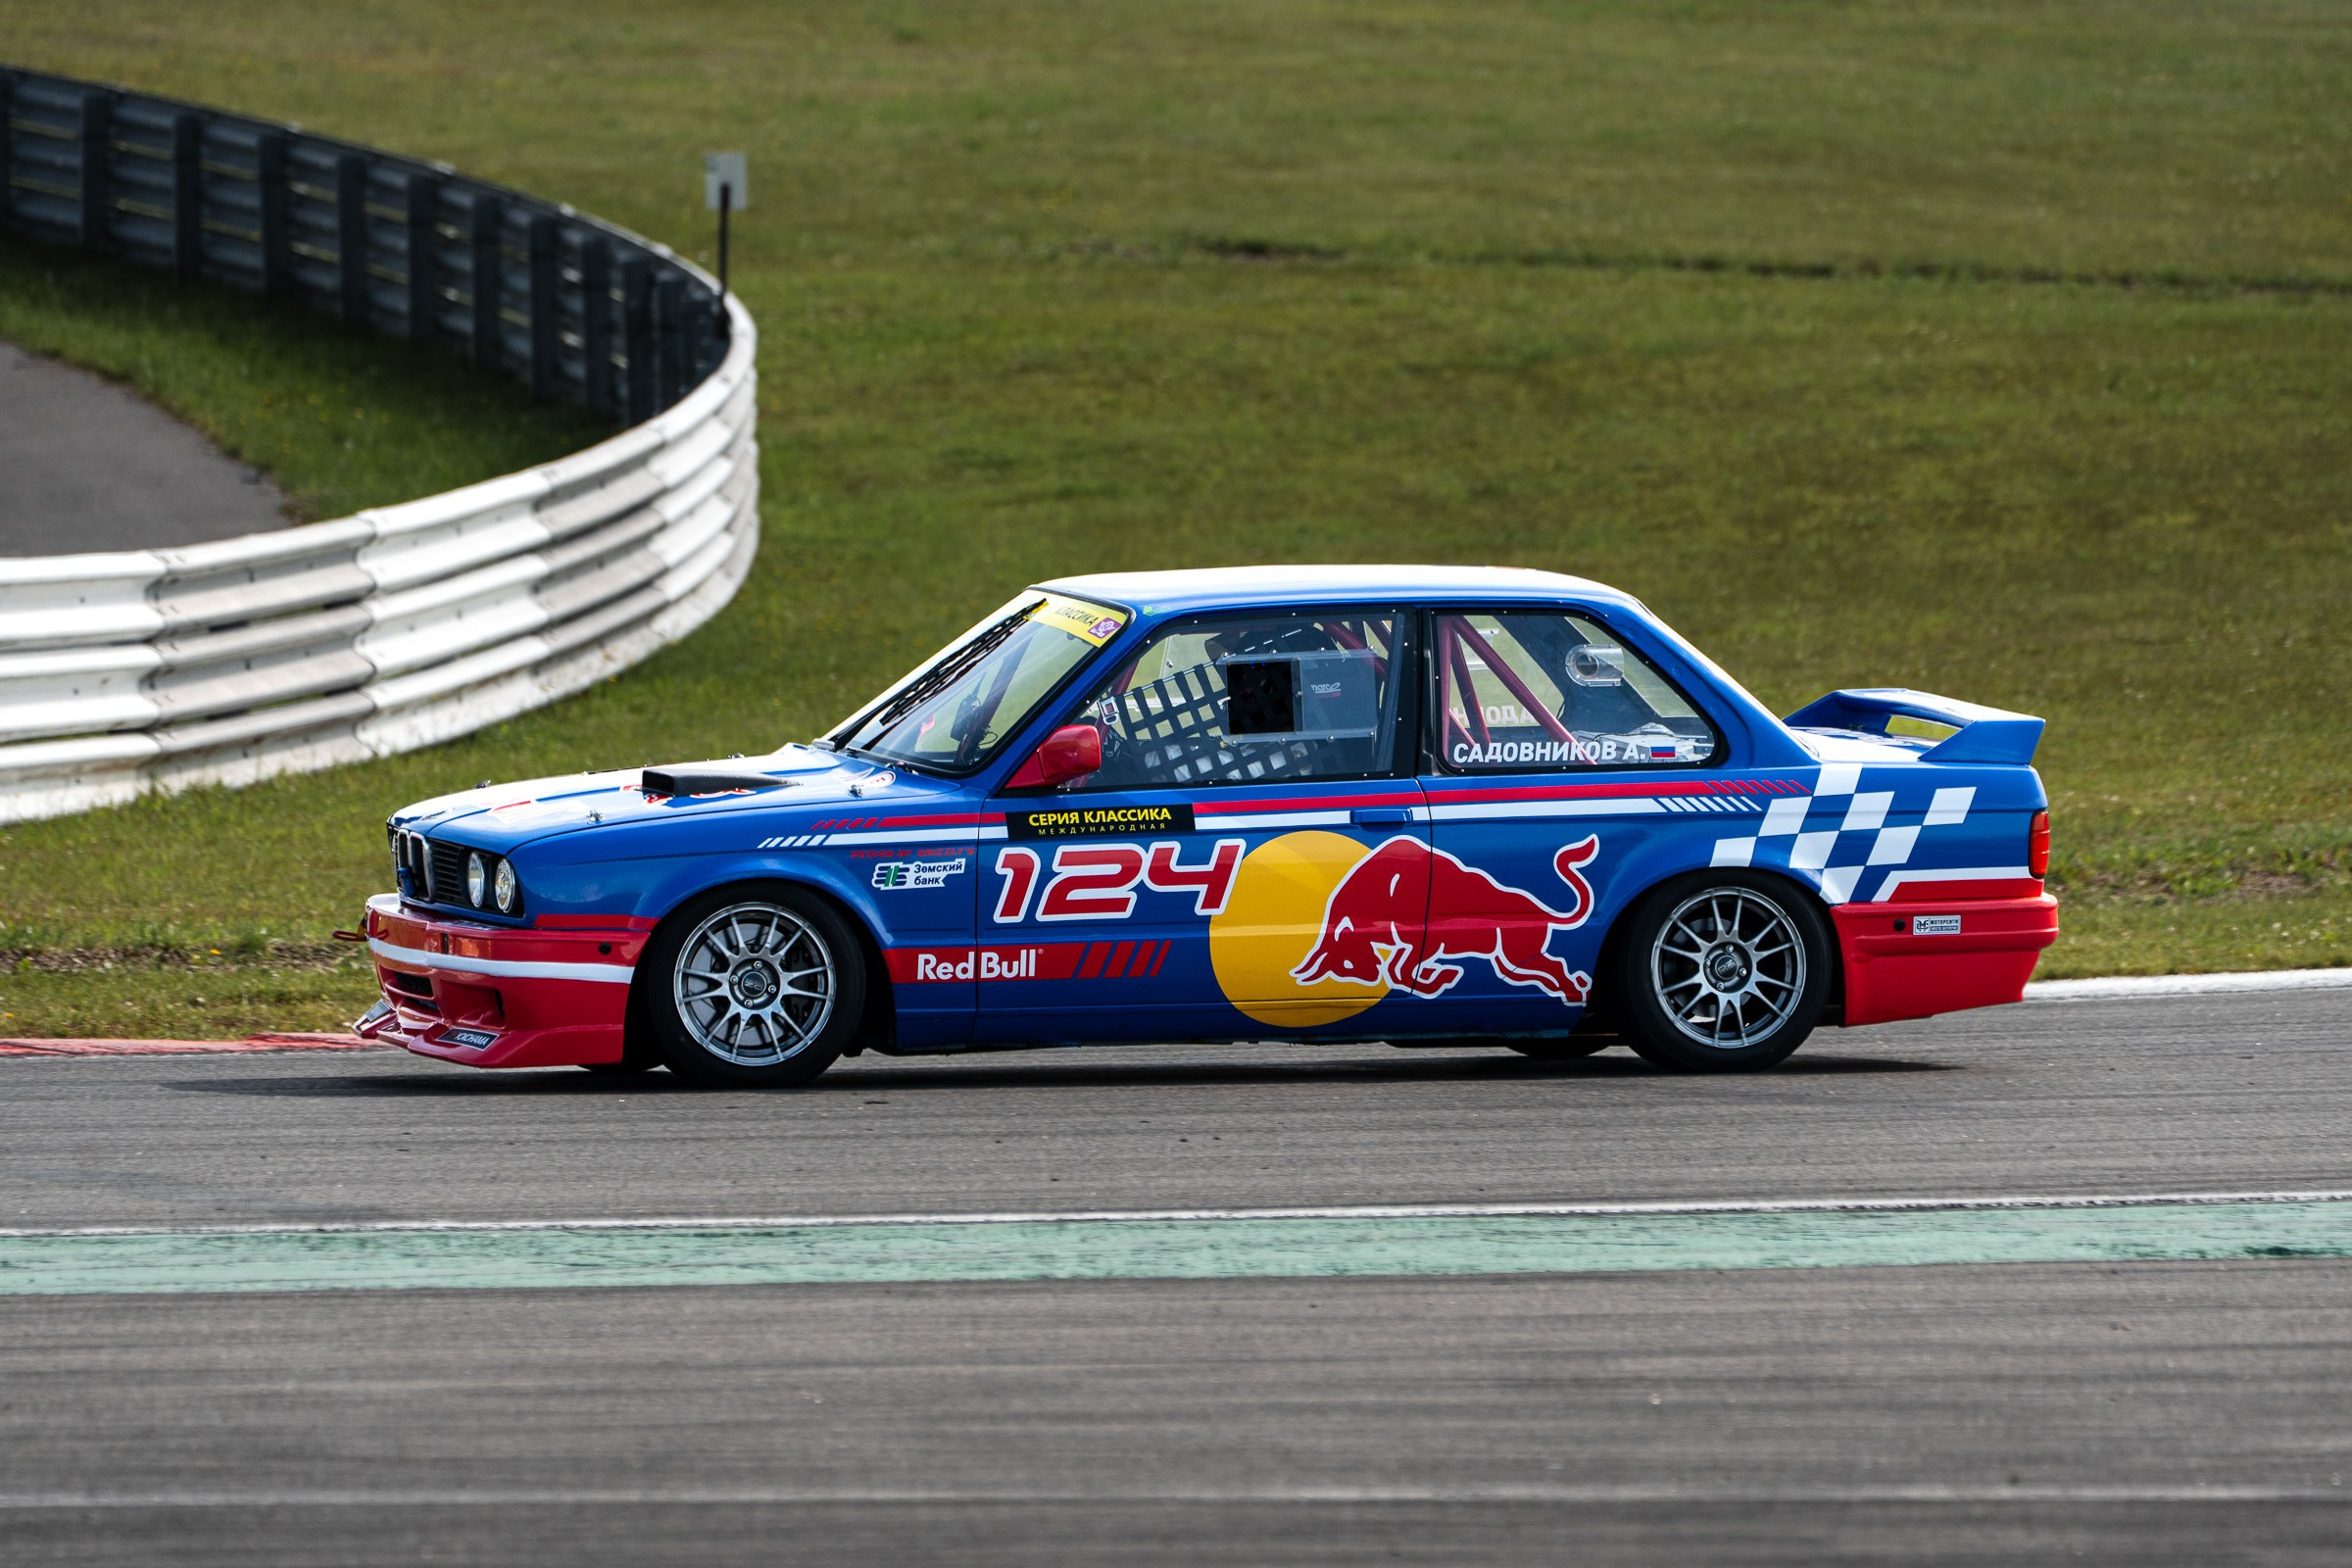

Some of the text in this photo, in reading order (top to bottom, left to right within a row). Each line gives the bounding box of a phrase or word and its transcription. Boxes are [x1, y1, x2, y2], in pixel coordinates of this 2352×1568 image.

[1453, 741, 1646, 763] САДОВНИКОВ А.
[1029, 808, 1172, 827] СЕРИЯ КЛАССИКА
[1038, 822, 1165, 836] МЕЖДУНАРОДНАЯ
[850, 850, 894, 858] DESIGN
[913, 860, 962, 873] Земский
[913, 875, 942, 886] банк
[993, 838, 1247, 923] 124
[917, 949, 1036, 980] Red Bull
